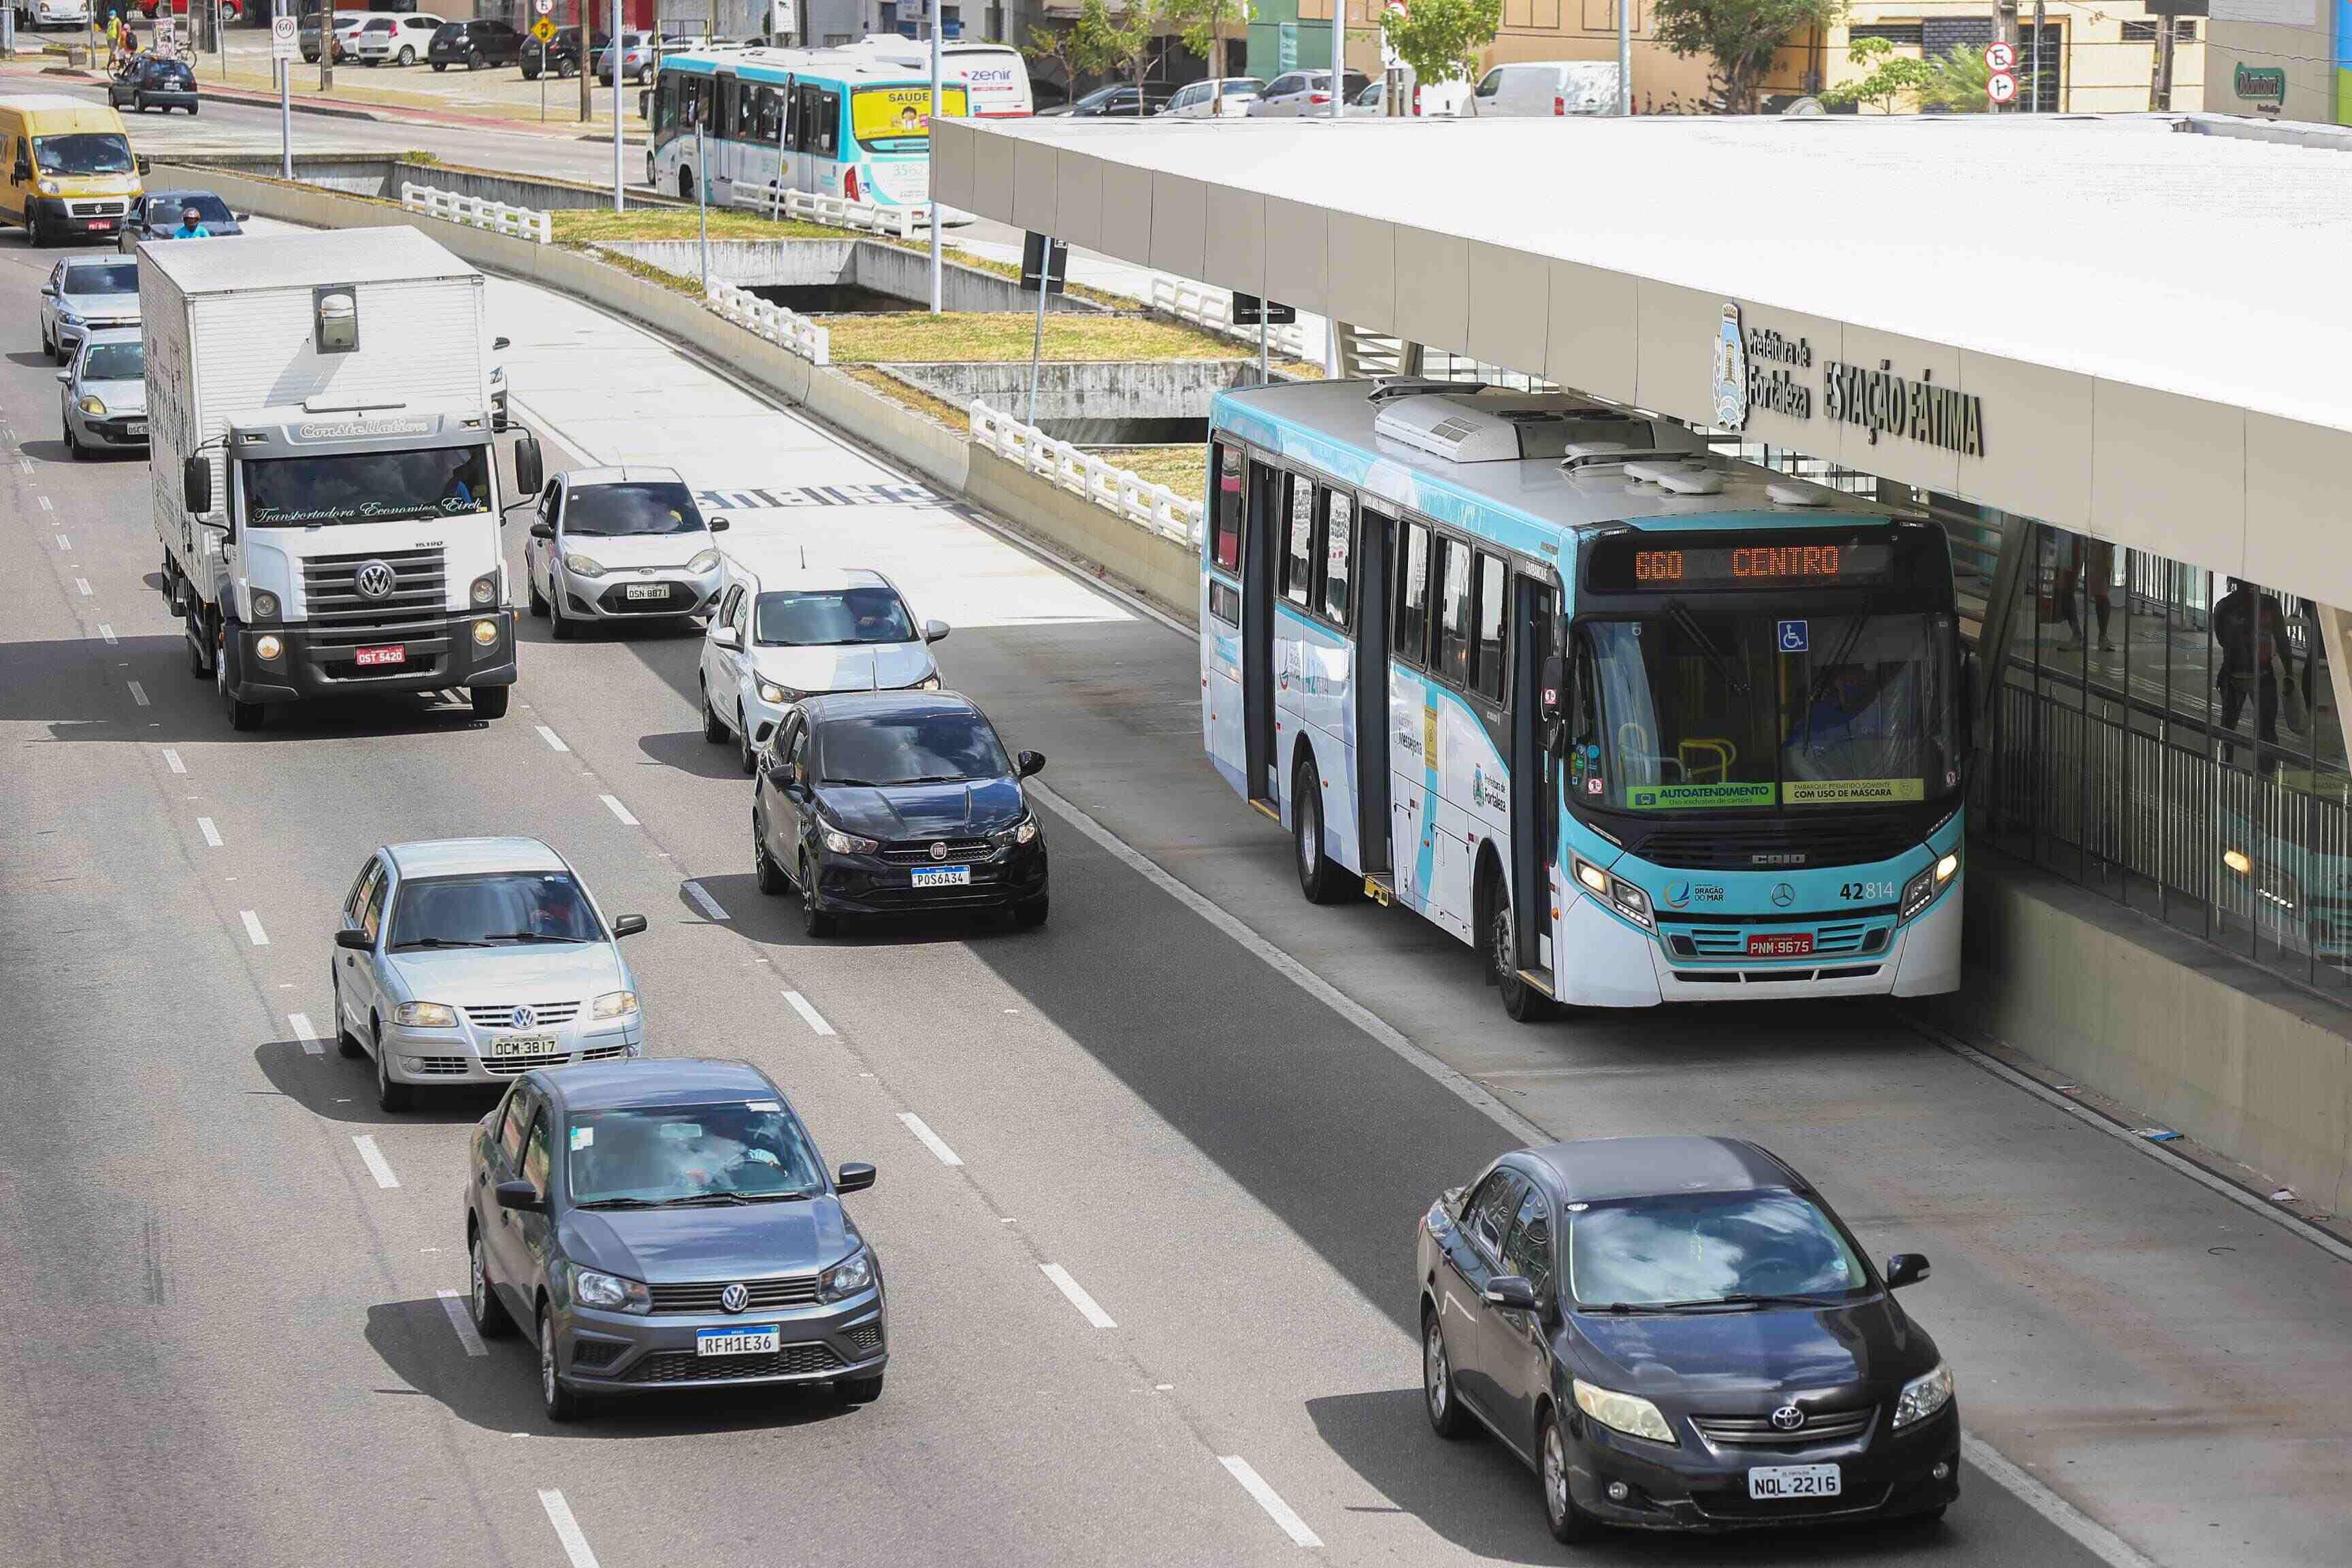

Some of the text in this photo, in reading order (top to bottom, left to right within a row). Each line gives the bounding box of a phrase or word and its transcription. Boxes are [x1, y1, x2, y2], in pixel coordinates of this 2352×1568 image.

[972, 67, 1011, 80] zenir
[1748, 327, 1810, 367] Prefeitura de
[1748, 365, 1810, 419] Fortaleza
[1824, 359, 1983, 457] ESTAÇÃO FÁTIMA
[299, 419, 429, 438] Constellation
[252, 506, 355, 524] Transportadora
[1635, 545, 1840, 580] 660 CENTRO
[1399, 730, 1422, 757] Messejana
[1484, 772, 1501, 789] Prefeitura
[1484, 785, 1506, 813] Fortaleza
[1660, 786, 1769, 798] AUTOATENDIMENTO
[1795, 787, 1892, 798] COM USO DE MÁSCARA
[917, 873, 963, 885] POS6A34
[1695, 886, 1724, 894] DRAGÃO
[1840, 881, 1895, 900] 42814
[705, 1335, 771, 1353] RFH1E36
